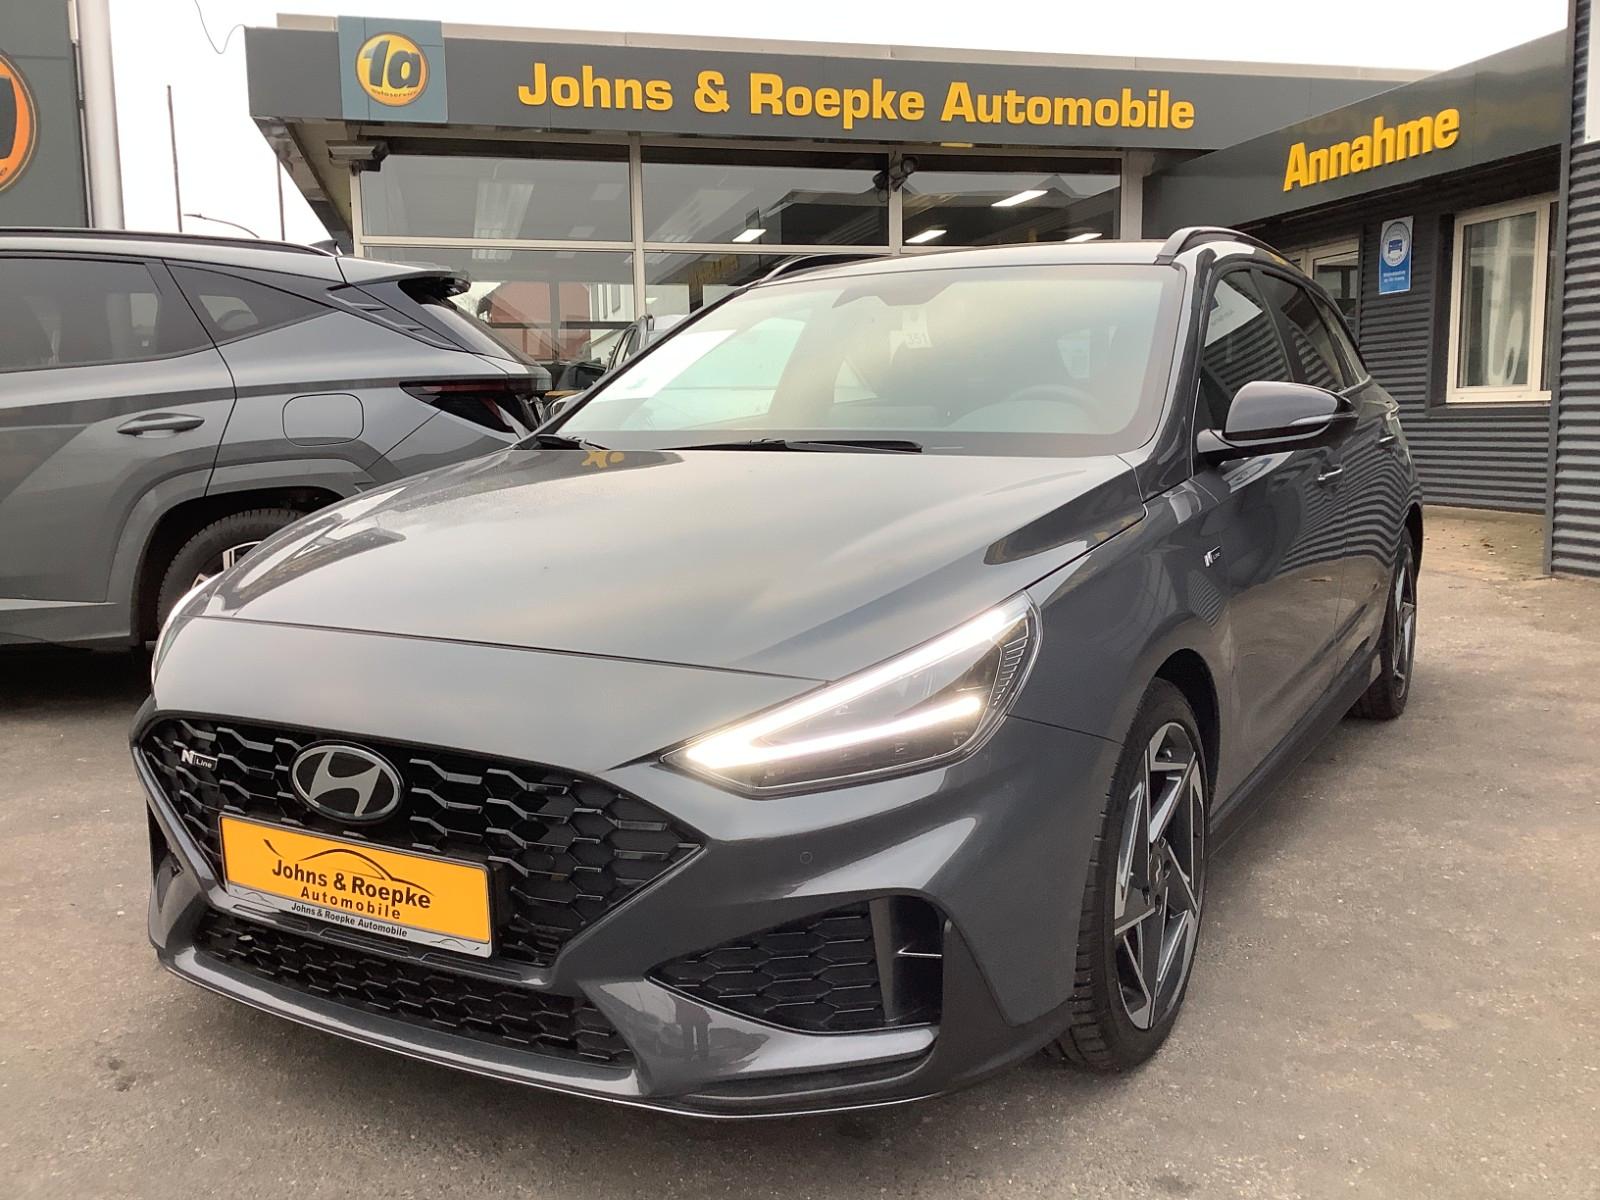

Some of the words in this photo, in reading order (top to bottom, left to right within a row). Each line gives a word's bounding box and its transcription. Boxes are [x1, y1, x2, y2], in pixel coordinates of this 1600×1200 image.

[363, 40, 421, 89] 1a
[517, 62, 673, 112] Johns
[693, 70, 730, 113] &
[749, 72, 926, 129] Roepke
[940, 81, 1195, 130] Automobile
[1282, 107, 1461, 192] Annahme
[196, 758, 213, 769] Line
[272, 859, 327, 887] Johns
[333, 872, 346, 891] &
[351, 875, 431, 909] Roepke
[300, 886, 401, 919] Automobile
[291, 902, 316, 916] Johns
[316, 909, 323, 917] &
[324, 910, 356, 926] Roepke
[357, 918, 408, 938] Automobile
